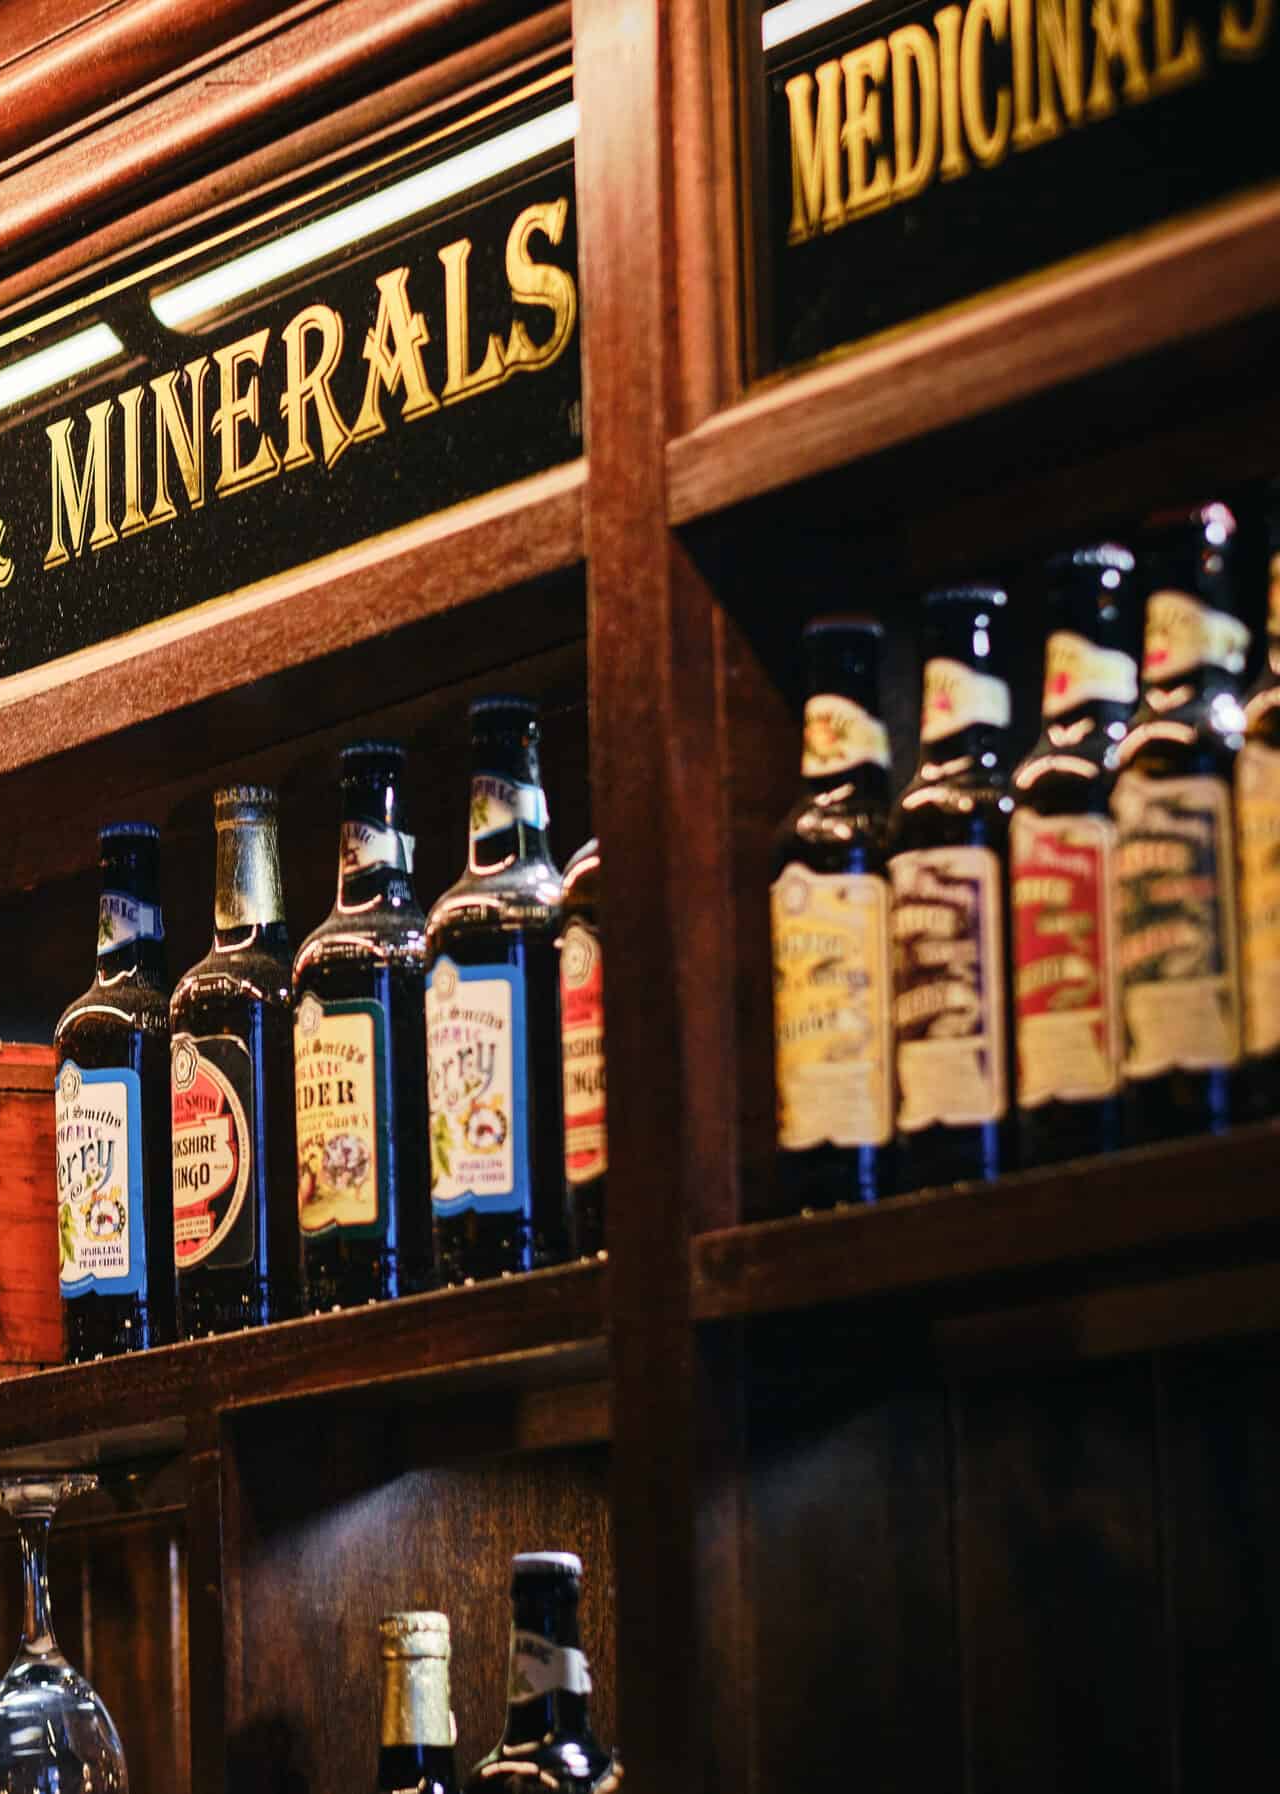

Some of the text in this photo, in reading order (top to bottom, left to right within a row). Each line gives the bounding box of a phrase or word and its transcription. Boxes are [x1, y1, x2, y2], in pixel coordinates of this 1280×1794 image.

[43, 197, 577, 571] MINERALS
[429, 1040, 496, 1101] erry
[296, 1080, 354, 1112] IDER
[57, 1138, 116, 1194] erry
[175, 1134, 217, 1159] KSHIRE
[174, 1162, 210, 1191] TINGO
